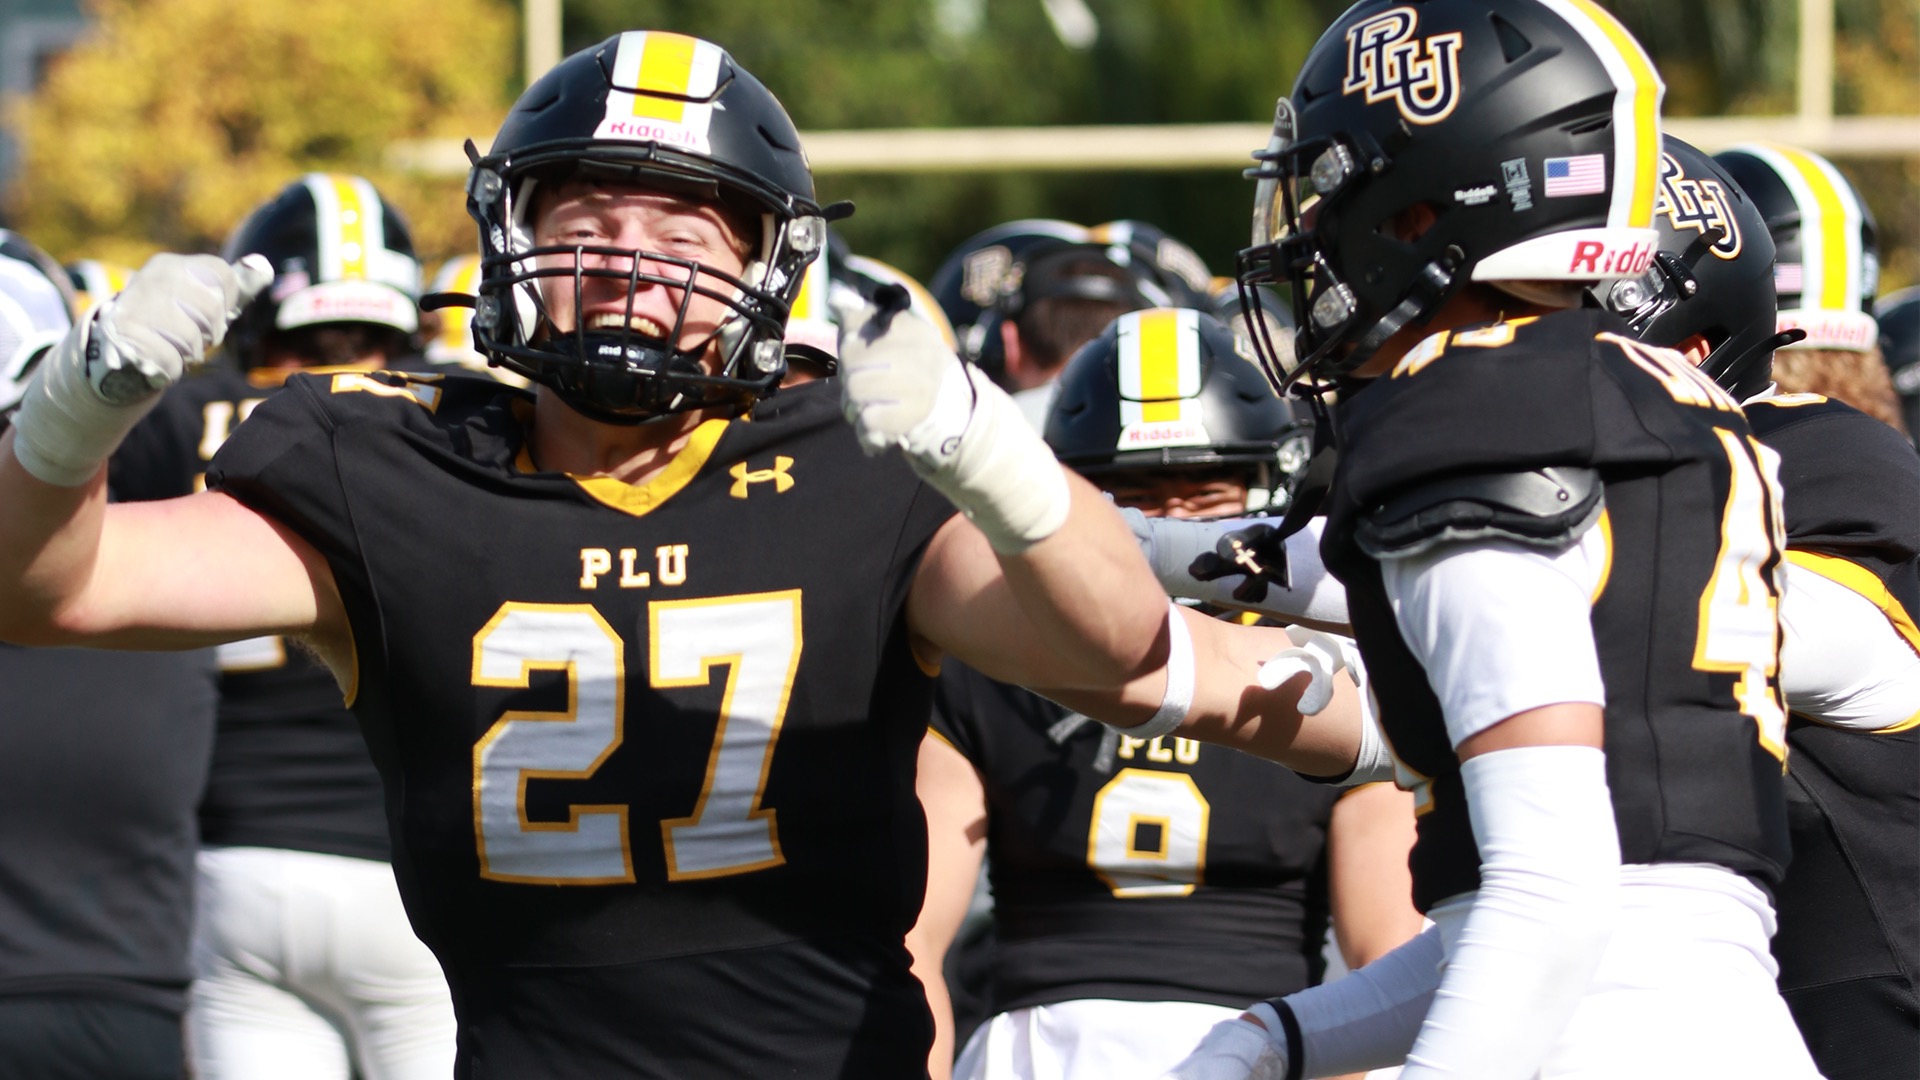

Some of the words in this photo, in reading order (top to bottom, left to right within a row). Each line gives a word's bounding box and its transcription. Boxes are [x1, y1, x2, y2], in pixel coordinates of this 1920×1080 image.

[1343, 6, 1463, 125] PLU
[580, 544, 689, 589] PLU
[471, 588, 803, 888] 27
